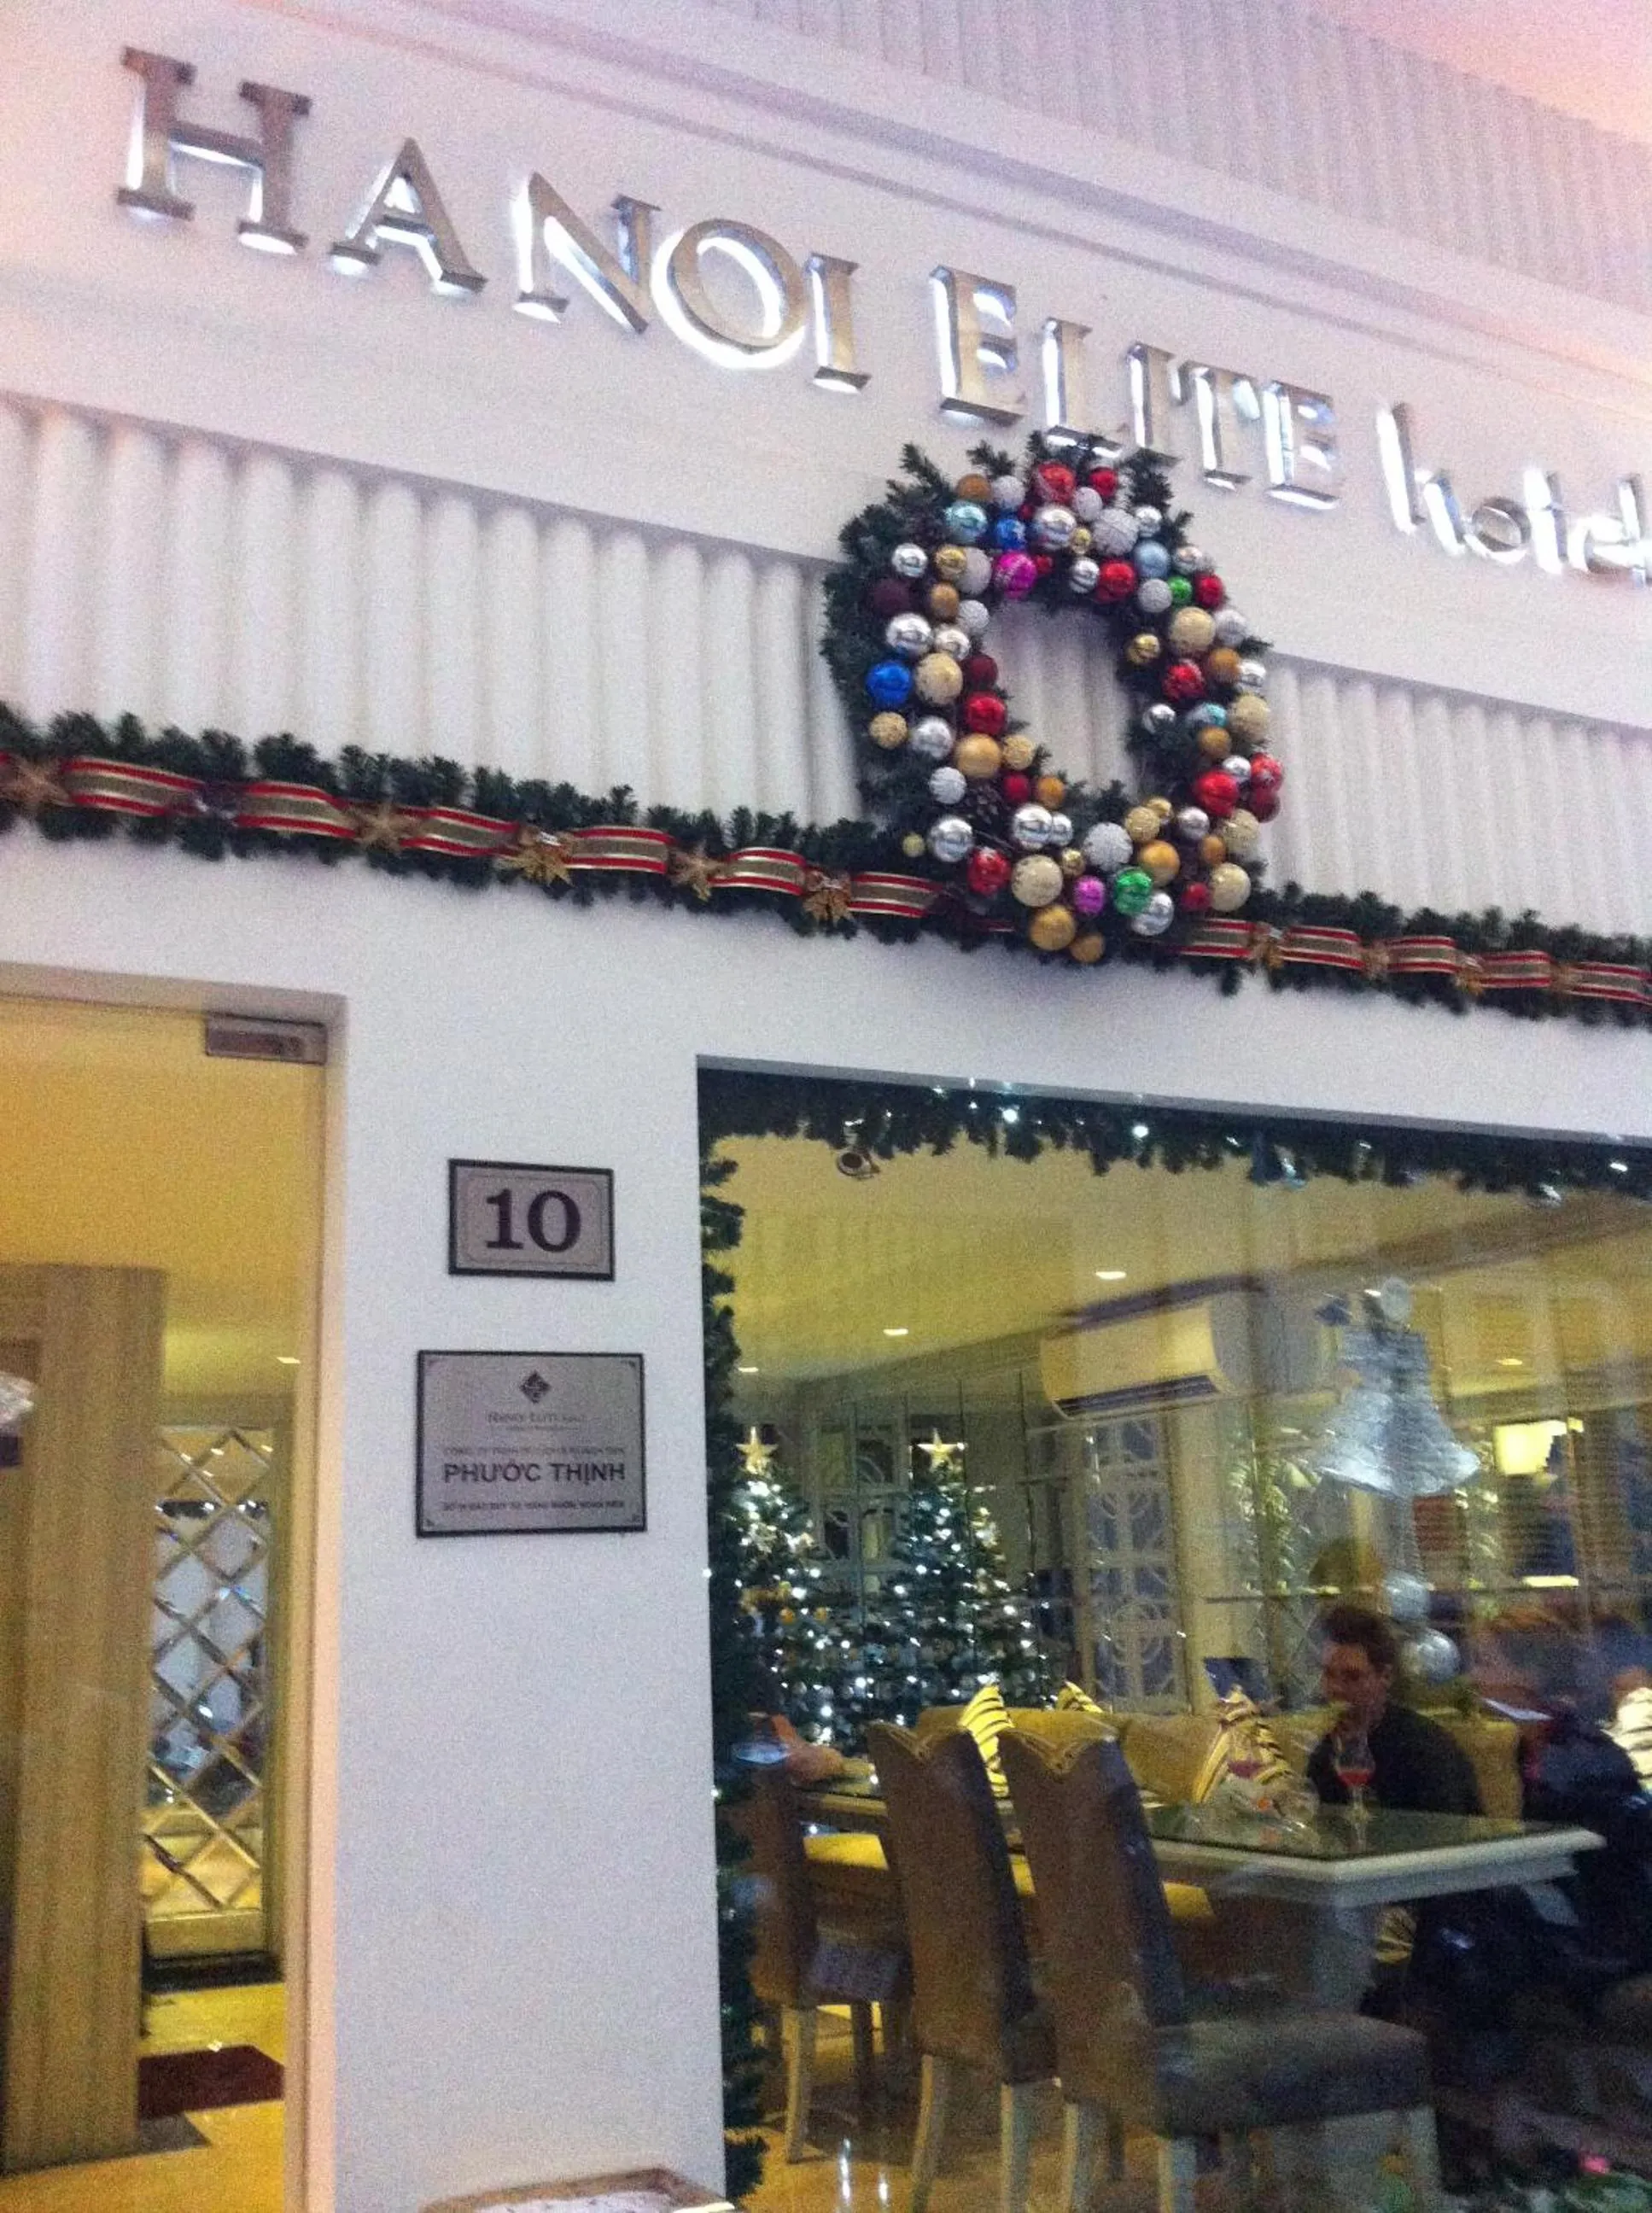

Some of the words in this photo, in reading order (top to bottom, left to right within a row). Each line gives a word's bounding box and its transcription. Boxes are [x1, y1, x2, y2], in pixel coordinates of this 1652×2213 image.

[116, 44, 872, 394] HANOI
[930, 264, 1340, 510] ELITE
[484, 1188, 581, 1253] 10
[549, 1462, 626, 1486] THỊNH
